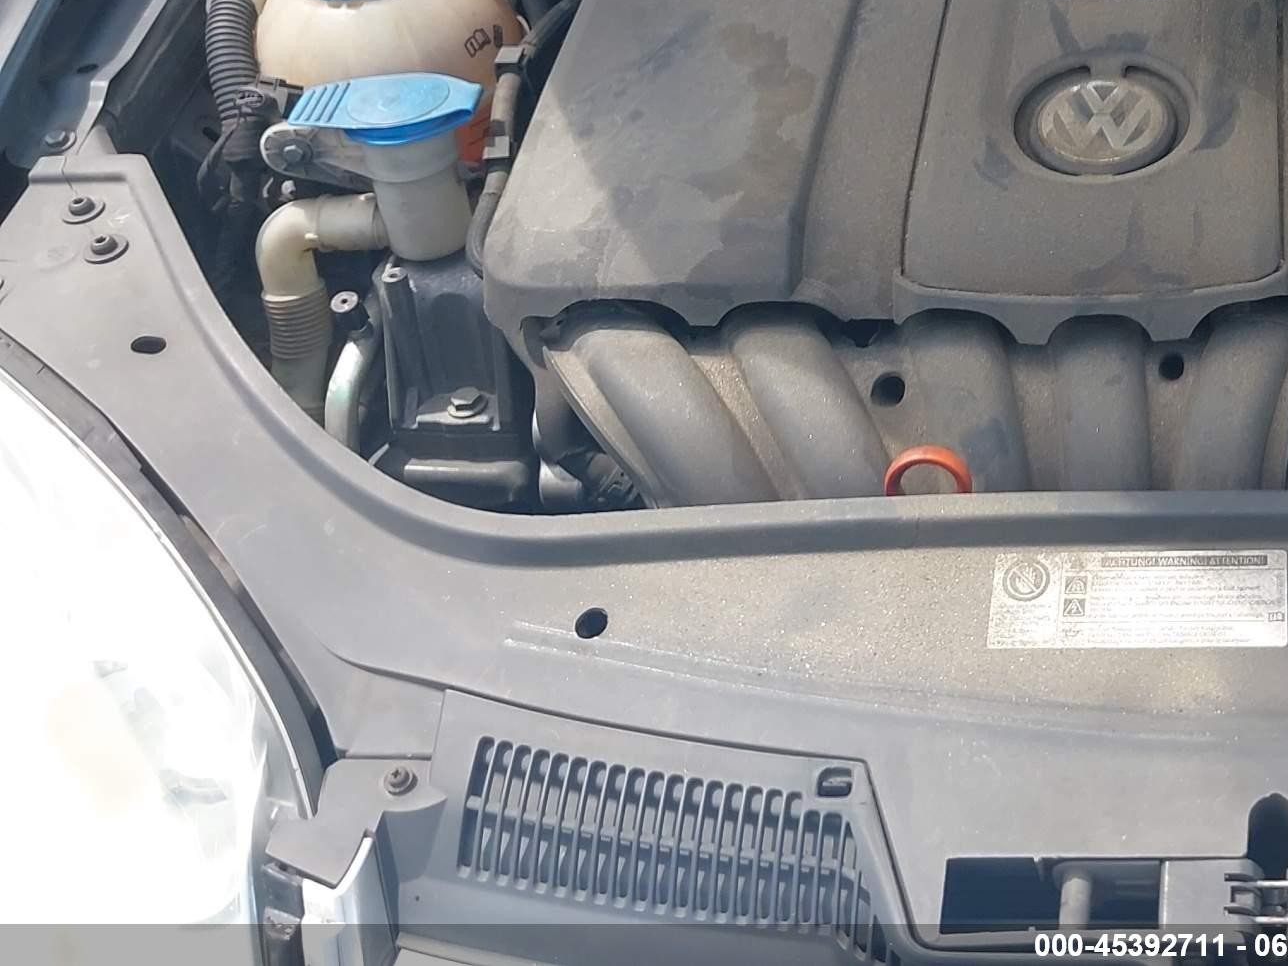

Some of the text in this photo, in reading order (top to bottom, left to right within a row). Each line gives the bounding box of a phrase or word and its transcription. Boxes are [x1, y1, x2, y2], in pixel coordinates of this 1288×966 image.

[1042, 80, 1161, 156] VW
[1157, 555, 1208, 567] WARNING!
[1209, 554, 1266, 566] ATTENTION!
